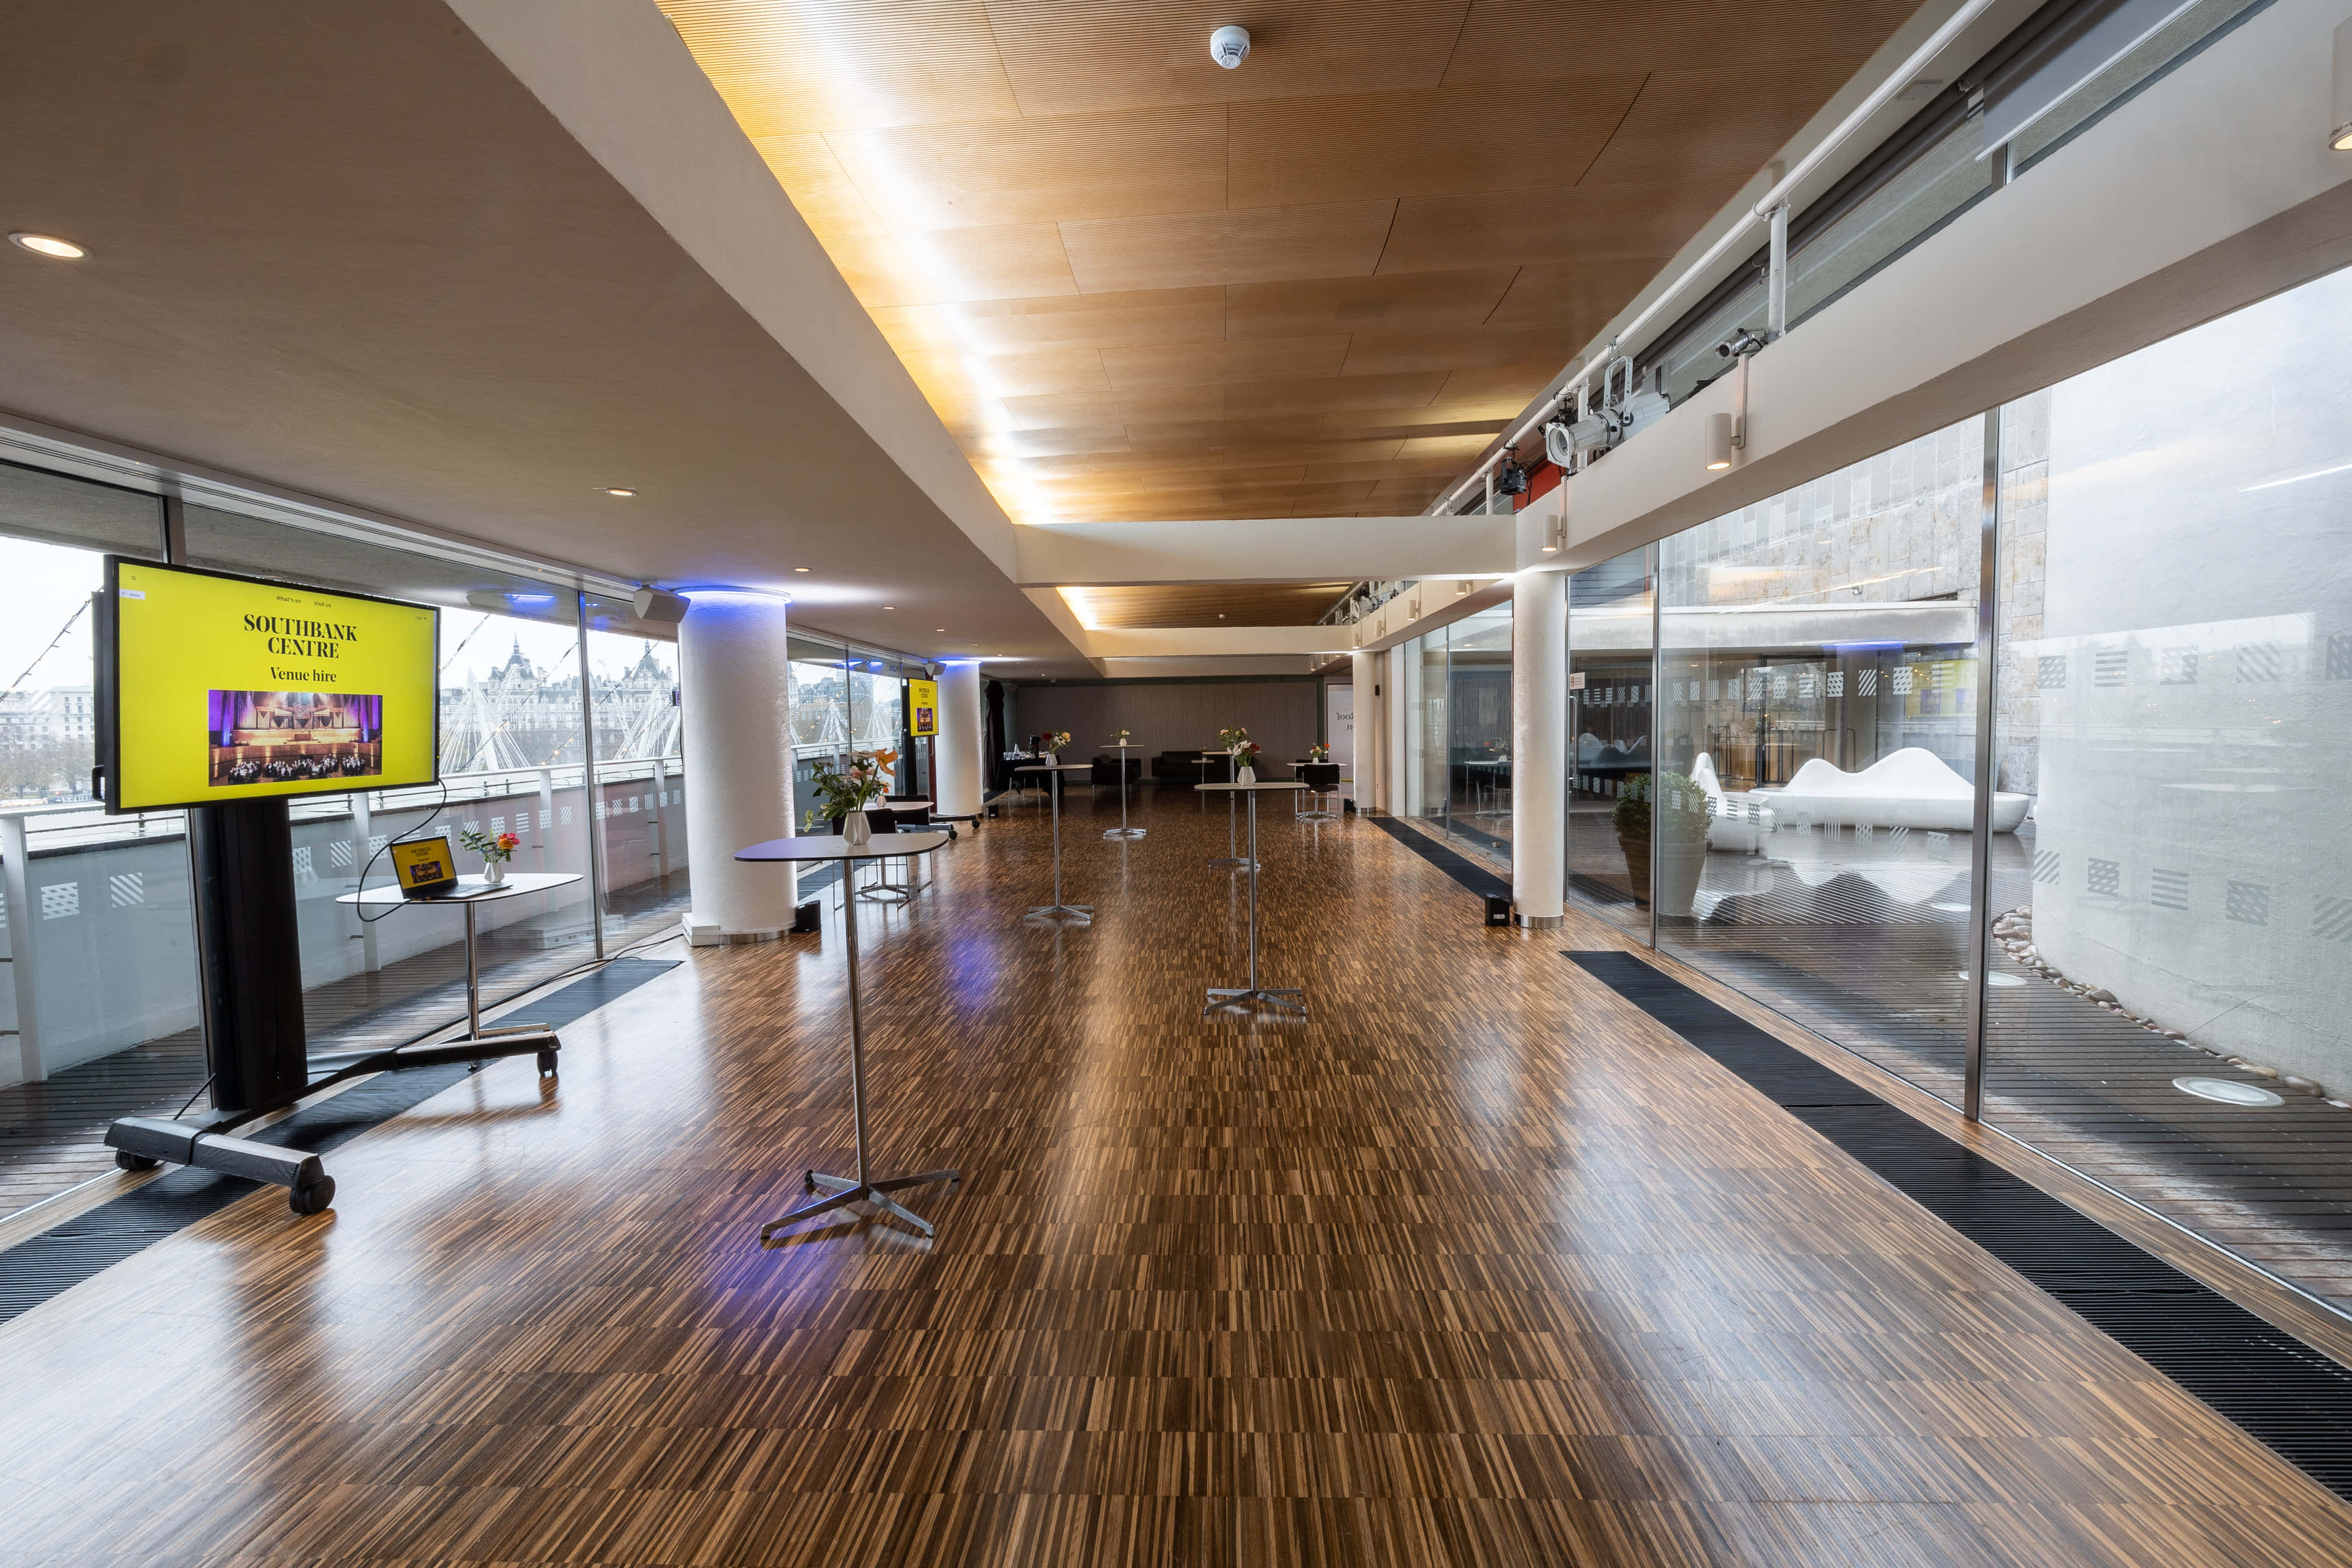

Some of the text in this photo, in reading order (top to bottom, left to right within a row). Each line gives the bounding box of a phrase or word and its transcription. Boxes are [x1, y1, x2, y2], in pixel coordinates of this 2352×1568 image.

[244, 614, 358, 642] SOUTHBANK
[268, 637, 339, 658] CENTRE
[270, 666, 337, 682] Venue hire
